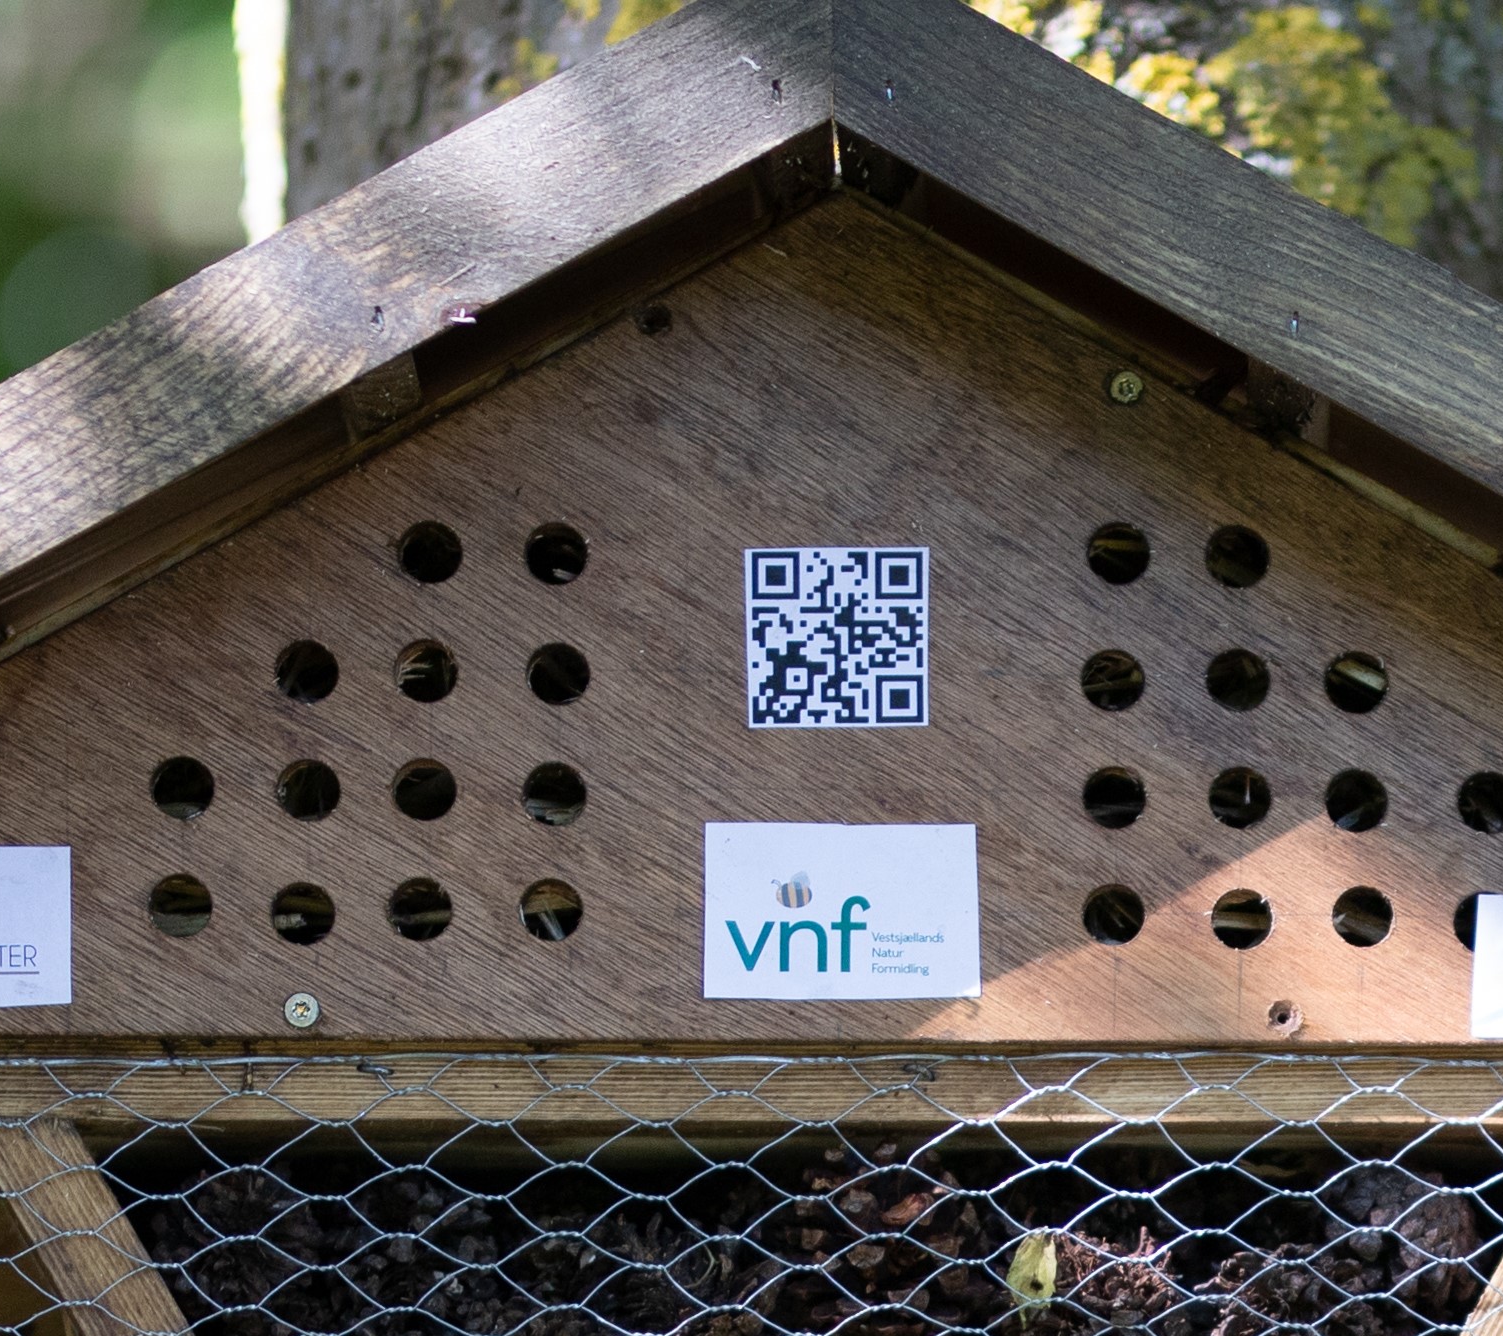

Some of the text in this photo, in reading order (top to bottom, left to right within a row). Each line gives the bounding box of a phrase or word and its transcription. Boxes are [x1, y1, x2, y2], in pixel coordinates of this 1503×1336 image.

[724, 895, 871, 973] vnf
[871, 931, 945, 945] Vestsjællands
[871, 947, 905, 959] Natur
[871, 963, 930, 976] Formidling
